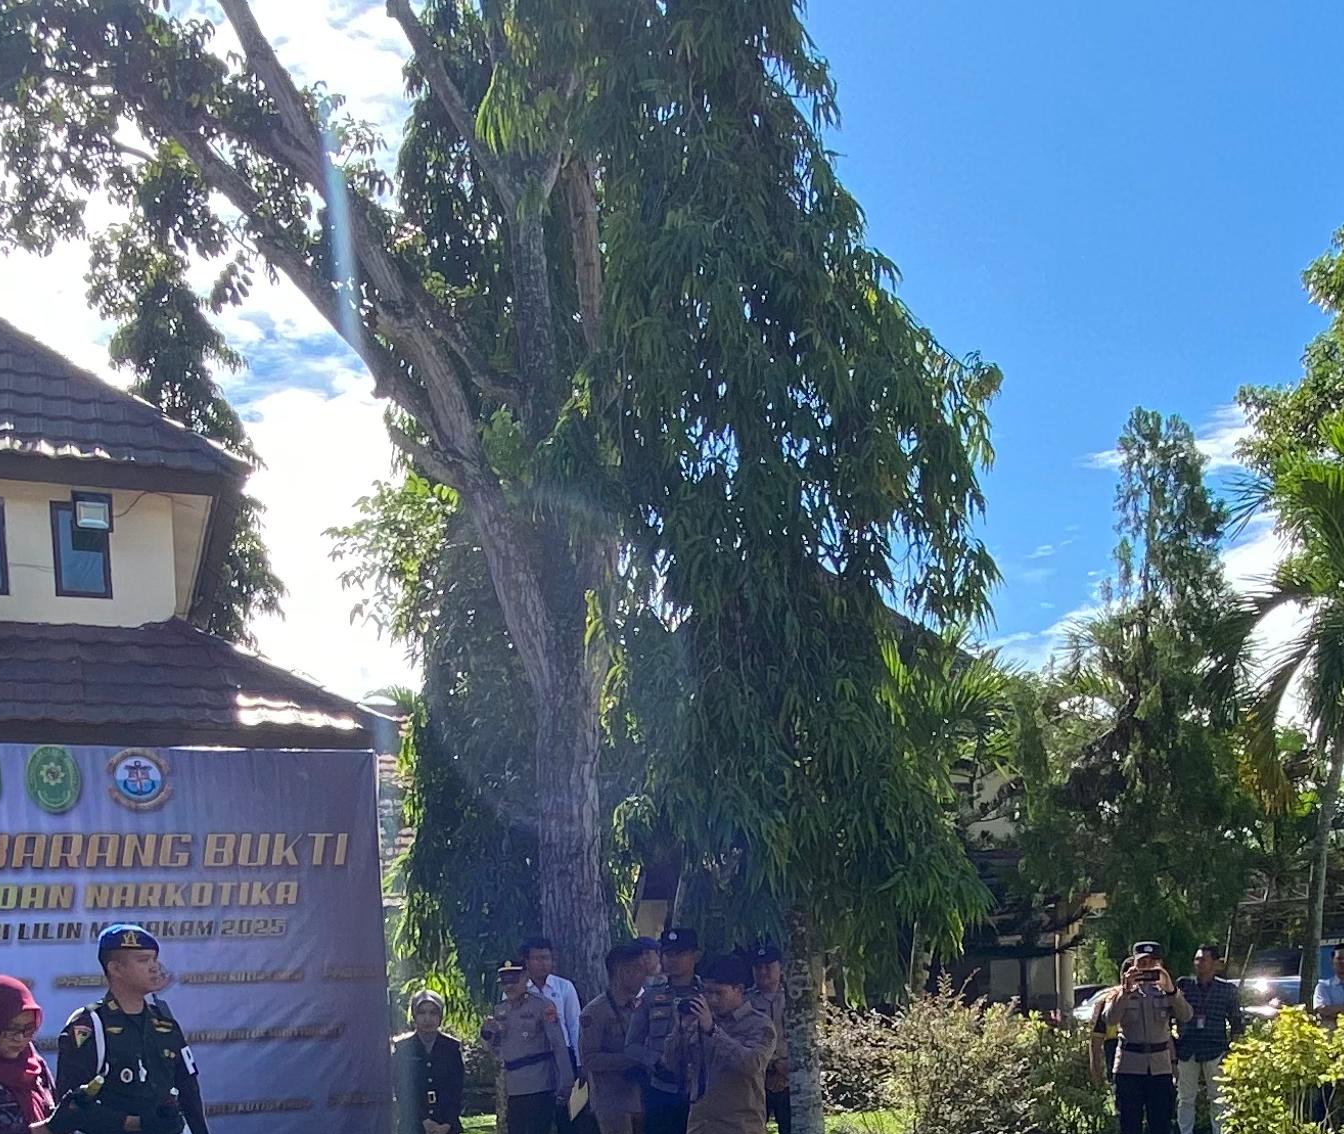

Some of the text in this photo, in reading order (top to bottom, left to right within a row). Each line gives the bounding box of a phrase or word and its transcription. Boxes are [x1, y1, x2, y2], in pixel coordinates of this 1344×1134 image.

[203, 832, 349, 867] BUKTI
[85, 880, 300, 909] NARKOTIKA
[17, 921, 83, 940] LILIN
[89, 919, 214, 940] MAKAM
[221, 919, 284, 937] 2025
